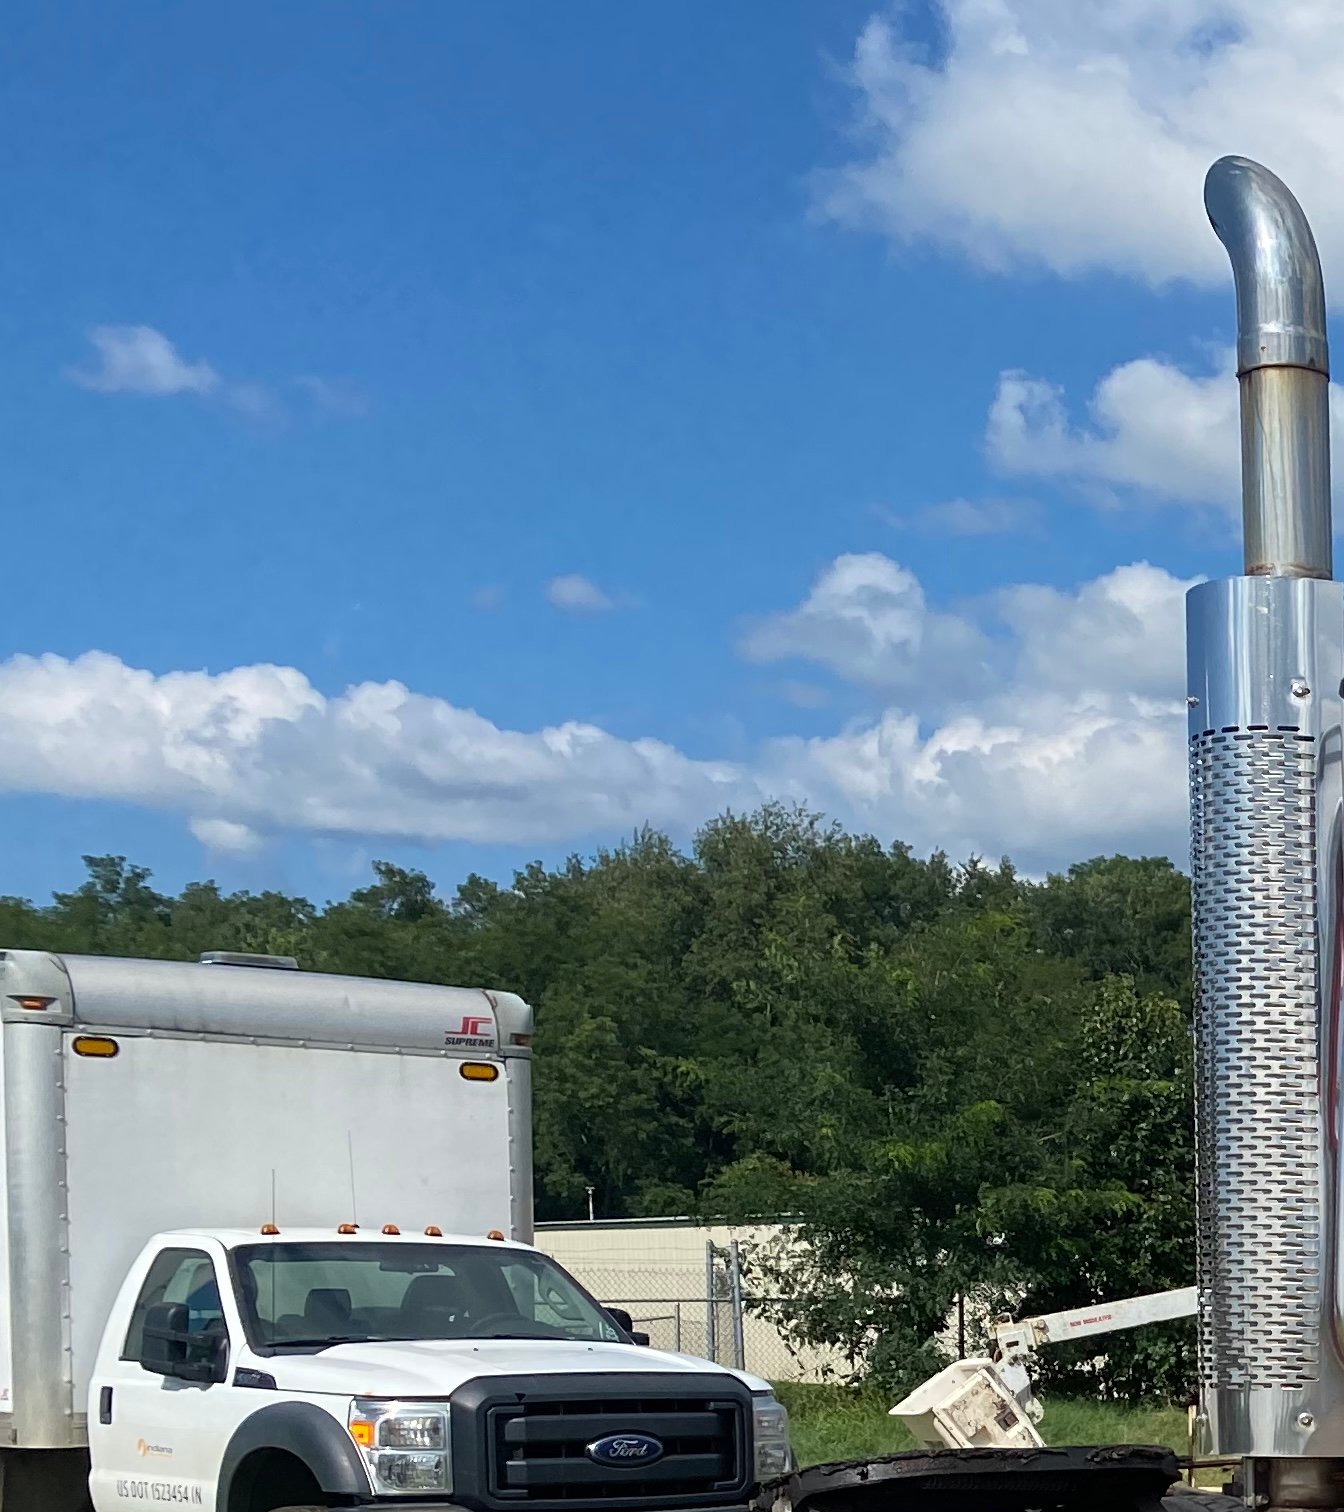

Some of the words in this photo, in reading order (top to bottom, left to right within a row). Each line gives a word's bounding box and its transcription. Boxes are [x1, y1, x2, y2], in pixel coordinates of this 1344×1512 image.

[444, 1036, 495, 1048] SUPREME
[609, 1439, 649, 1458] Ford
[116, 1479, 129, 1498] US
[131, 1481, 149, 1500] DOT
[151, 1482, 189, 1503] 1523454
[191, 1485, 203, 1505] IN
